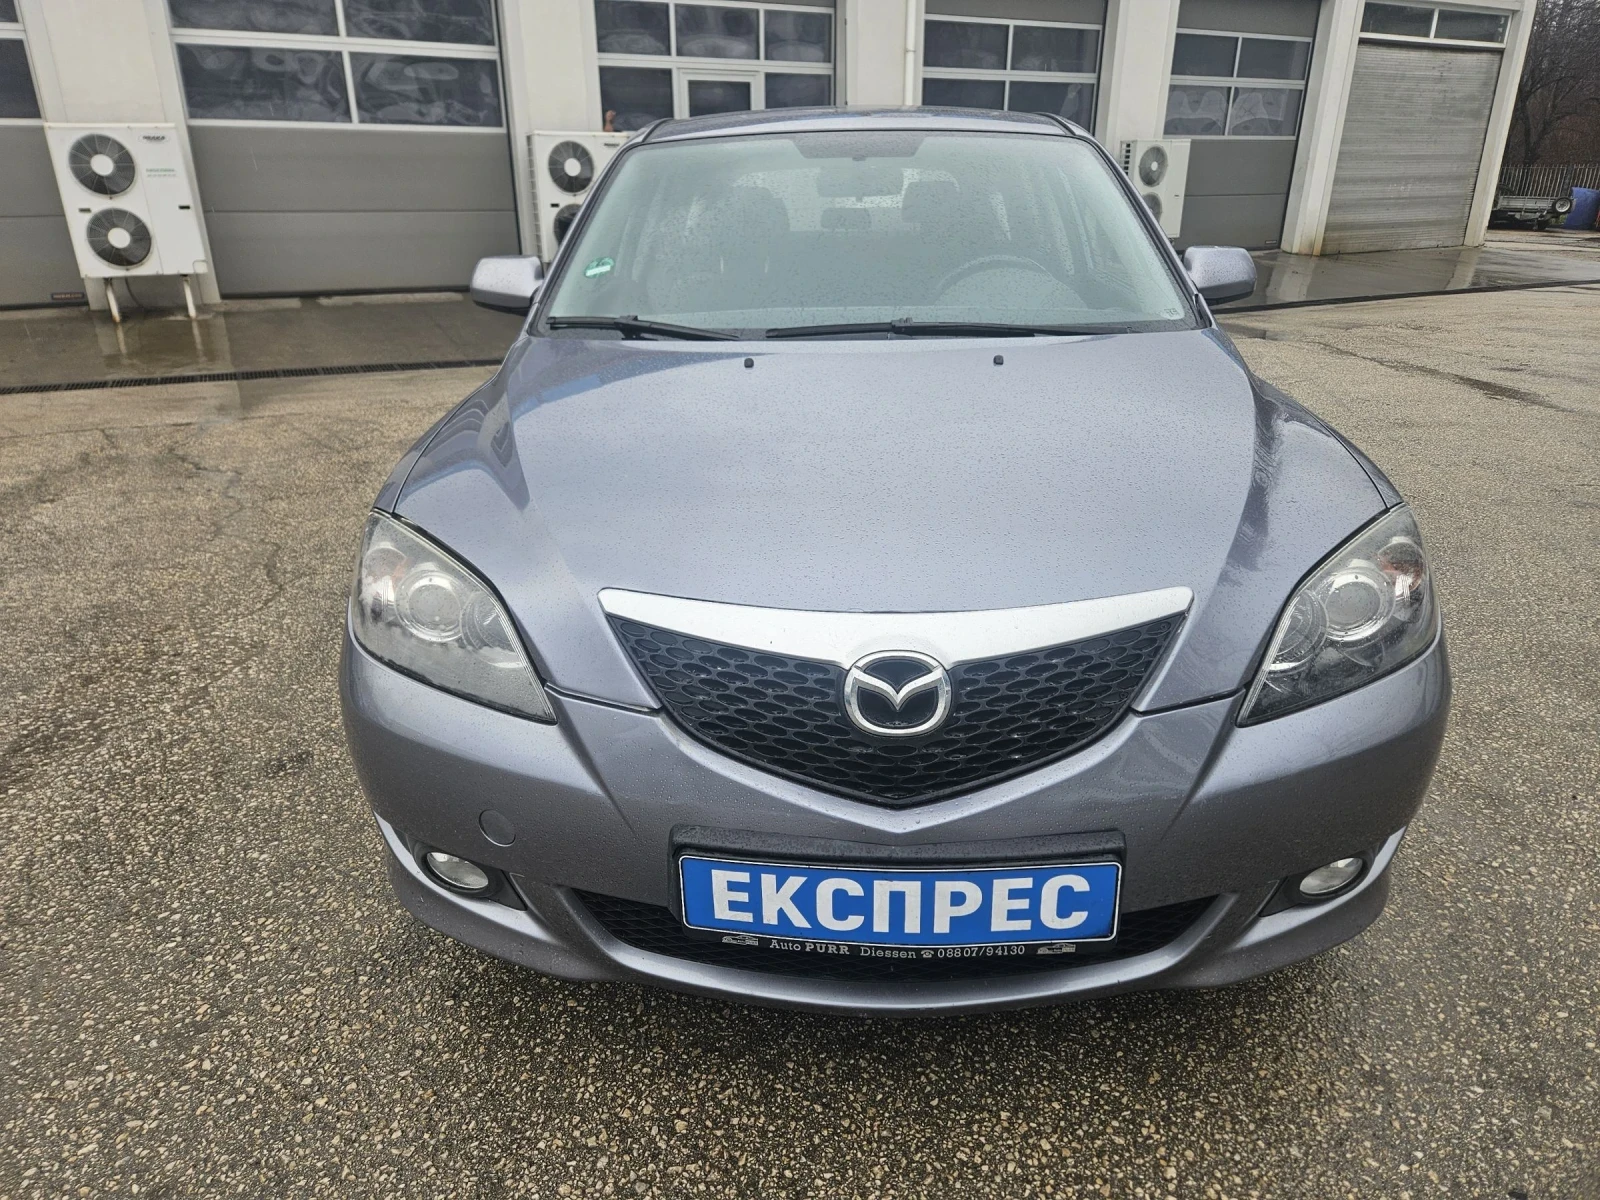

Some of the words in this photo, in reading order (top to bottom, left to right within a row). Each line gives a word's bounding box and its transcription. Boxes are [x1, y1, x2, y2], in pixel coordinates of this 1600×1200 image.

[711, 868, 1091, 934] ЕКСПРЕС
[769, 939, 801, 951] Auto
[805, 942, 850, 955] PURR
[860, 946, 917, 959] Diessen
[937, 945, 1025, 958] 08807/94130
